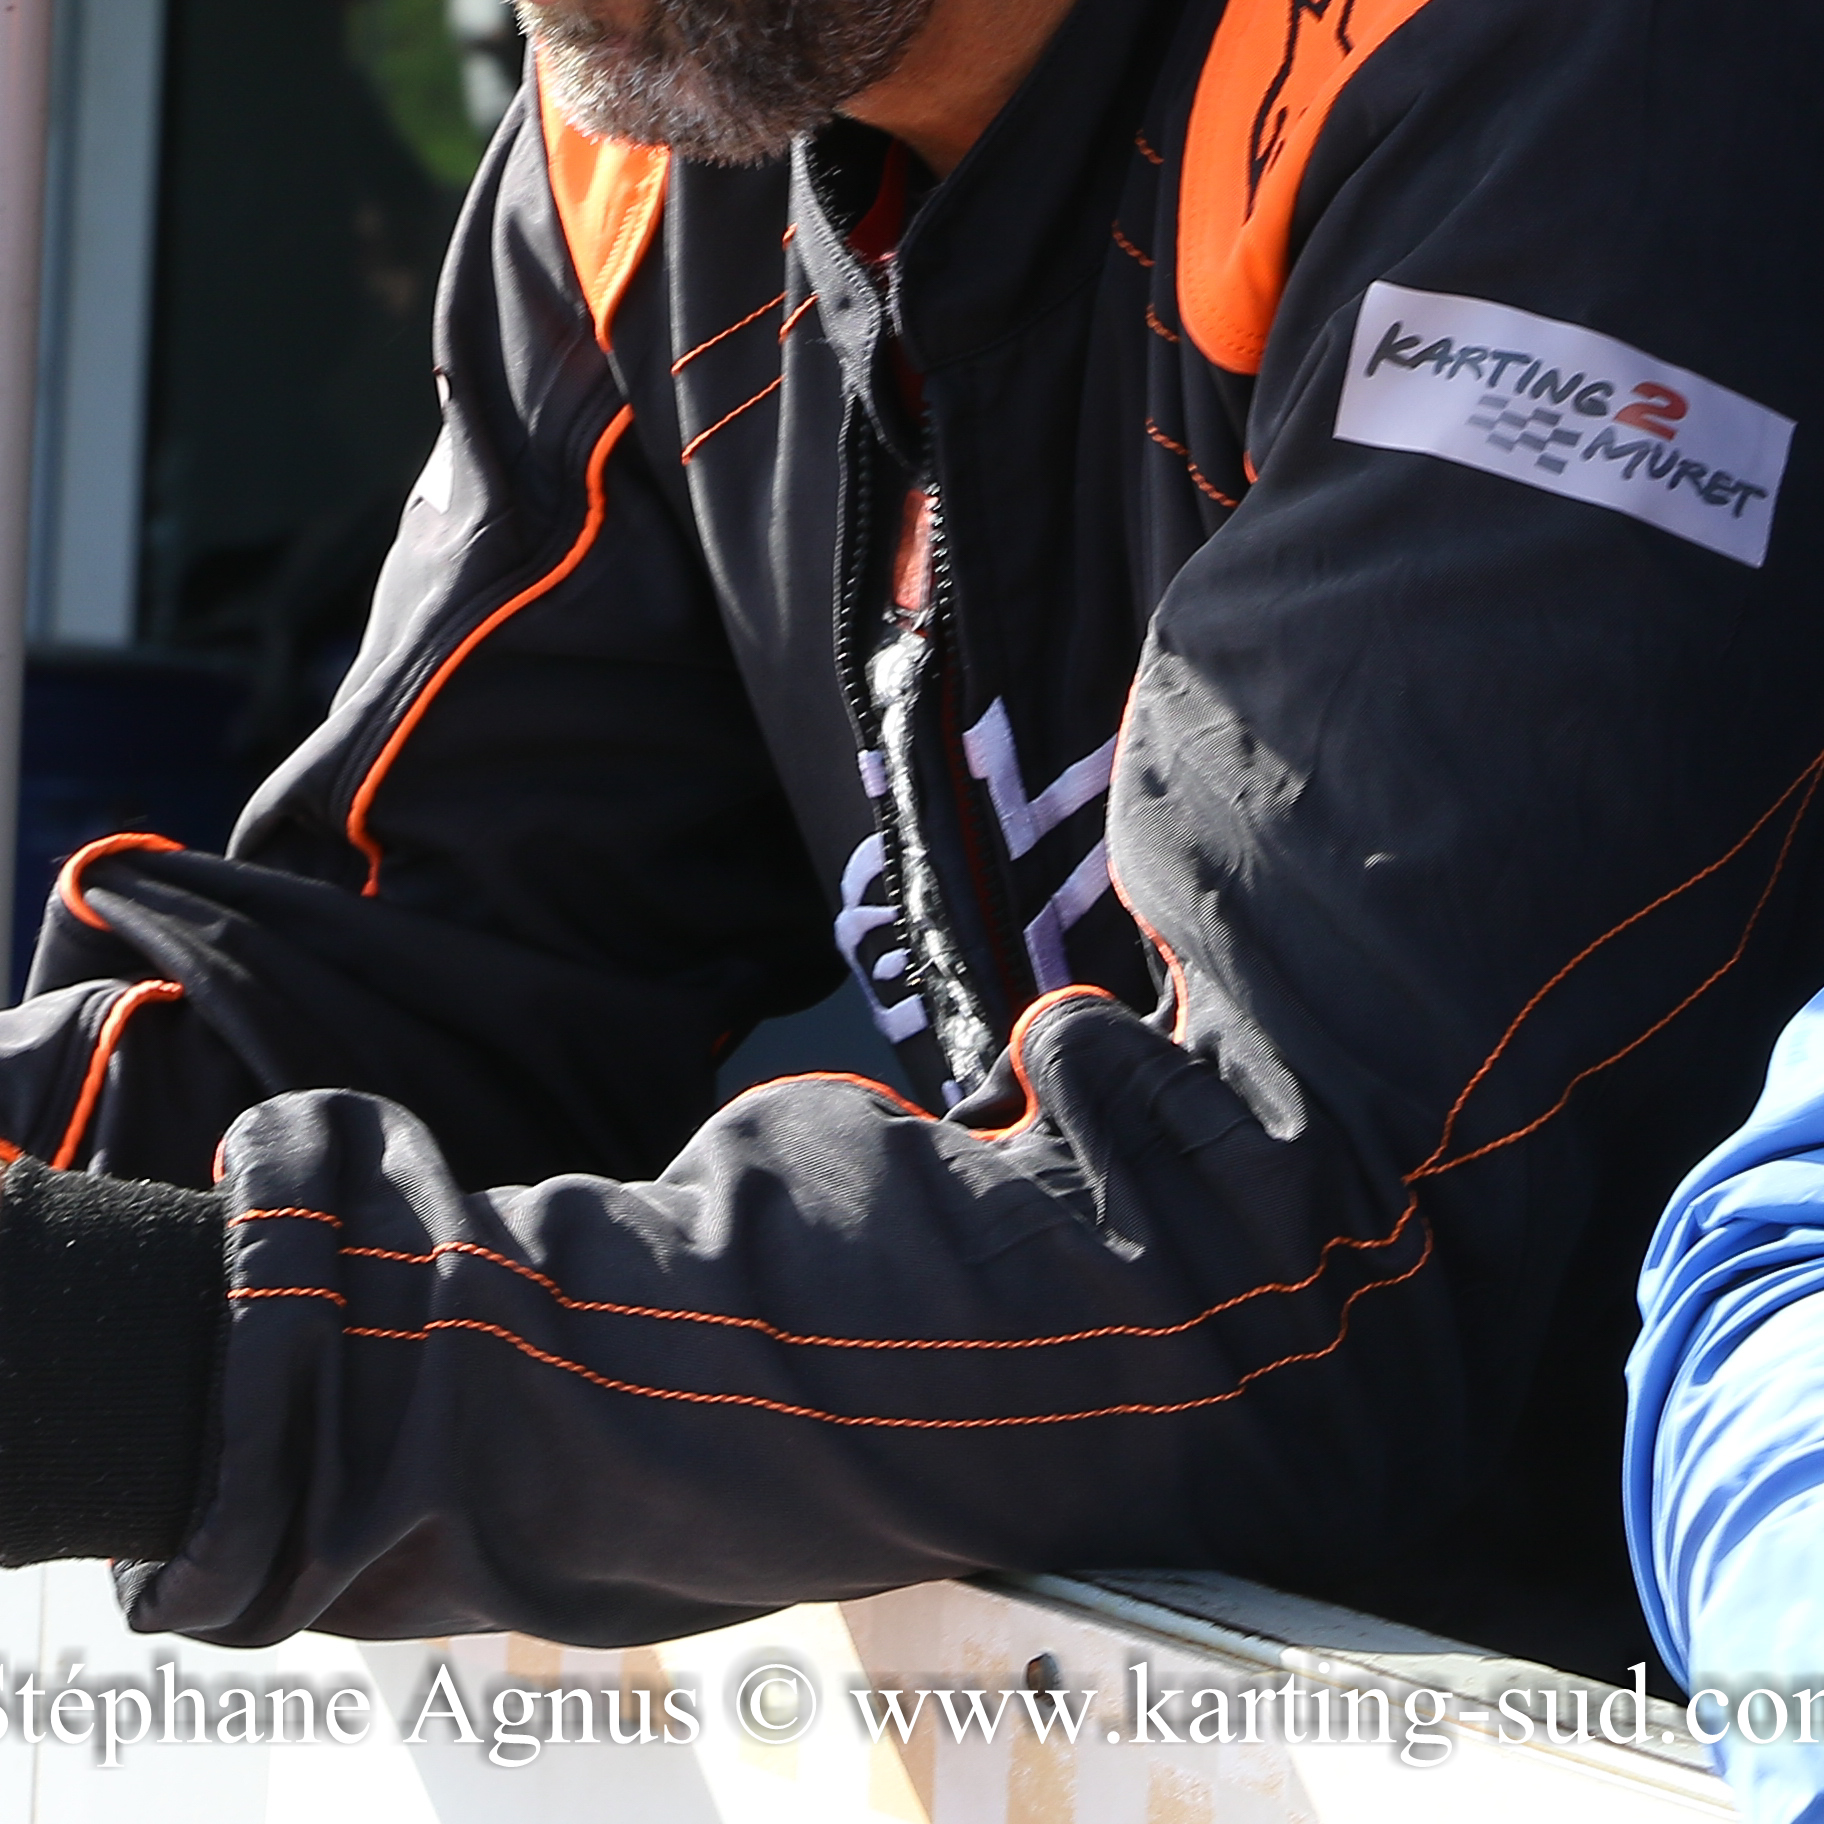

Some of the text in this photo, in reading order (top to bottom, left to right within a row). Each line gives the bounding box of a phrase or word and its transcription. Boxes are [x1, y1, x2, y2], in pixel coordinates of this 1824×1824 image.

[1368, 321, 1688, 441] KARTING 2
[1584, 426, 1767, 519] MURET
